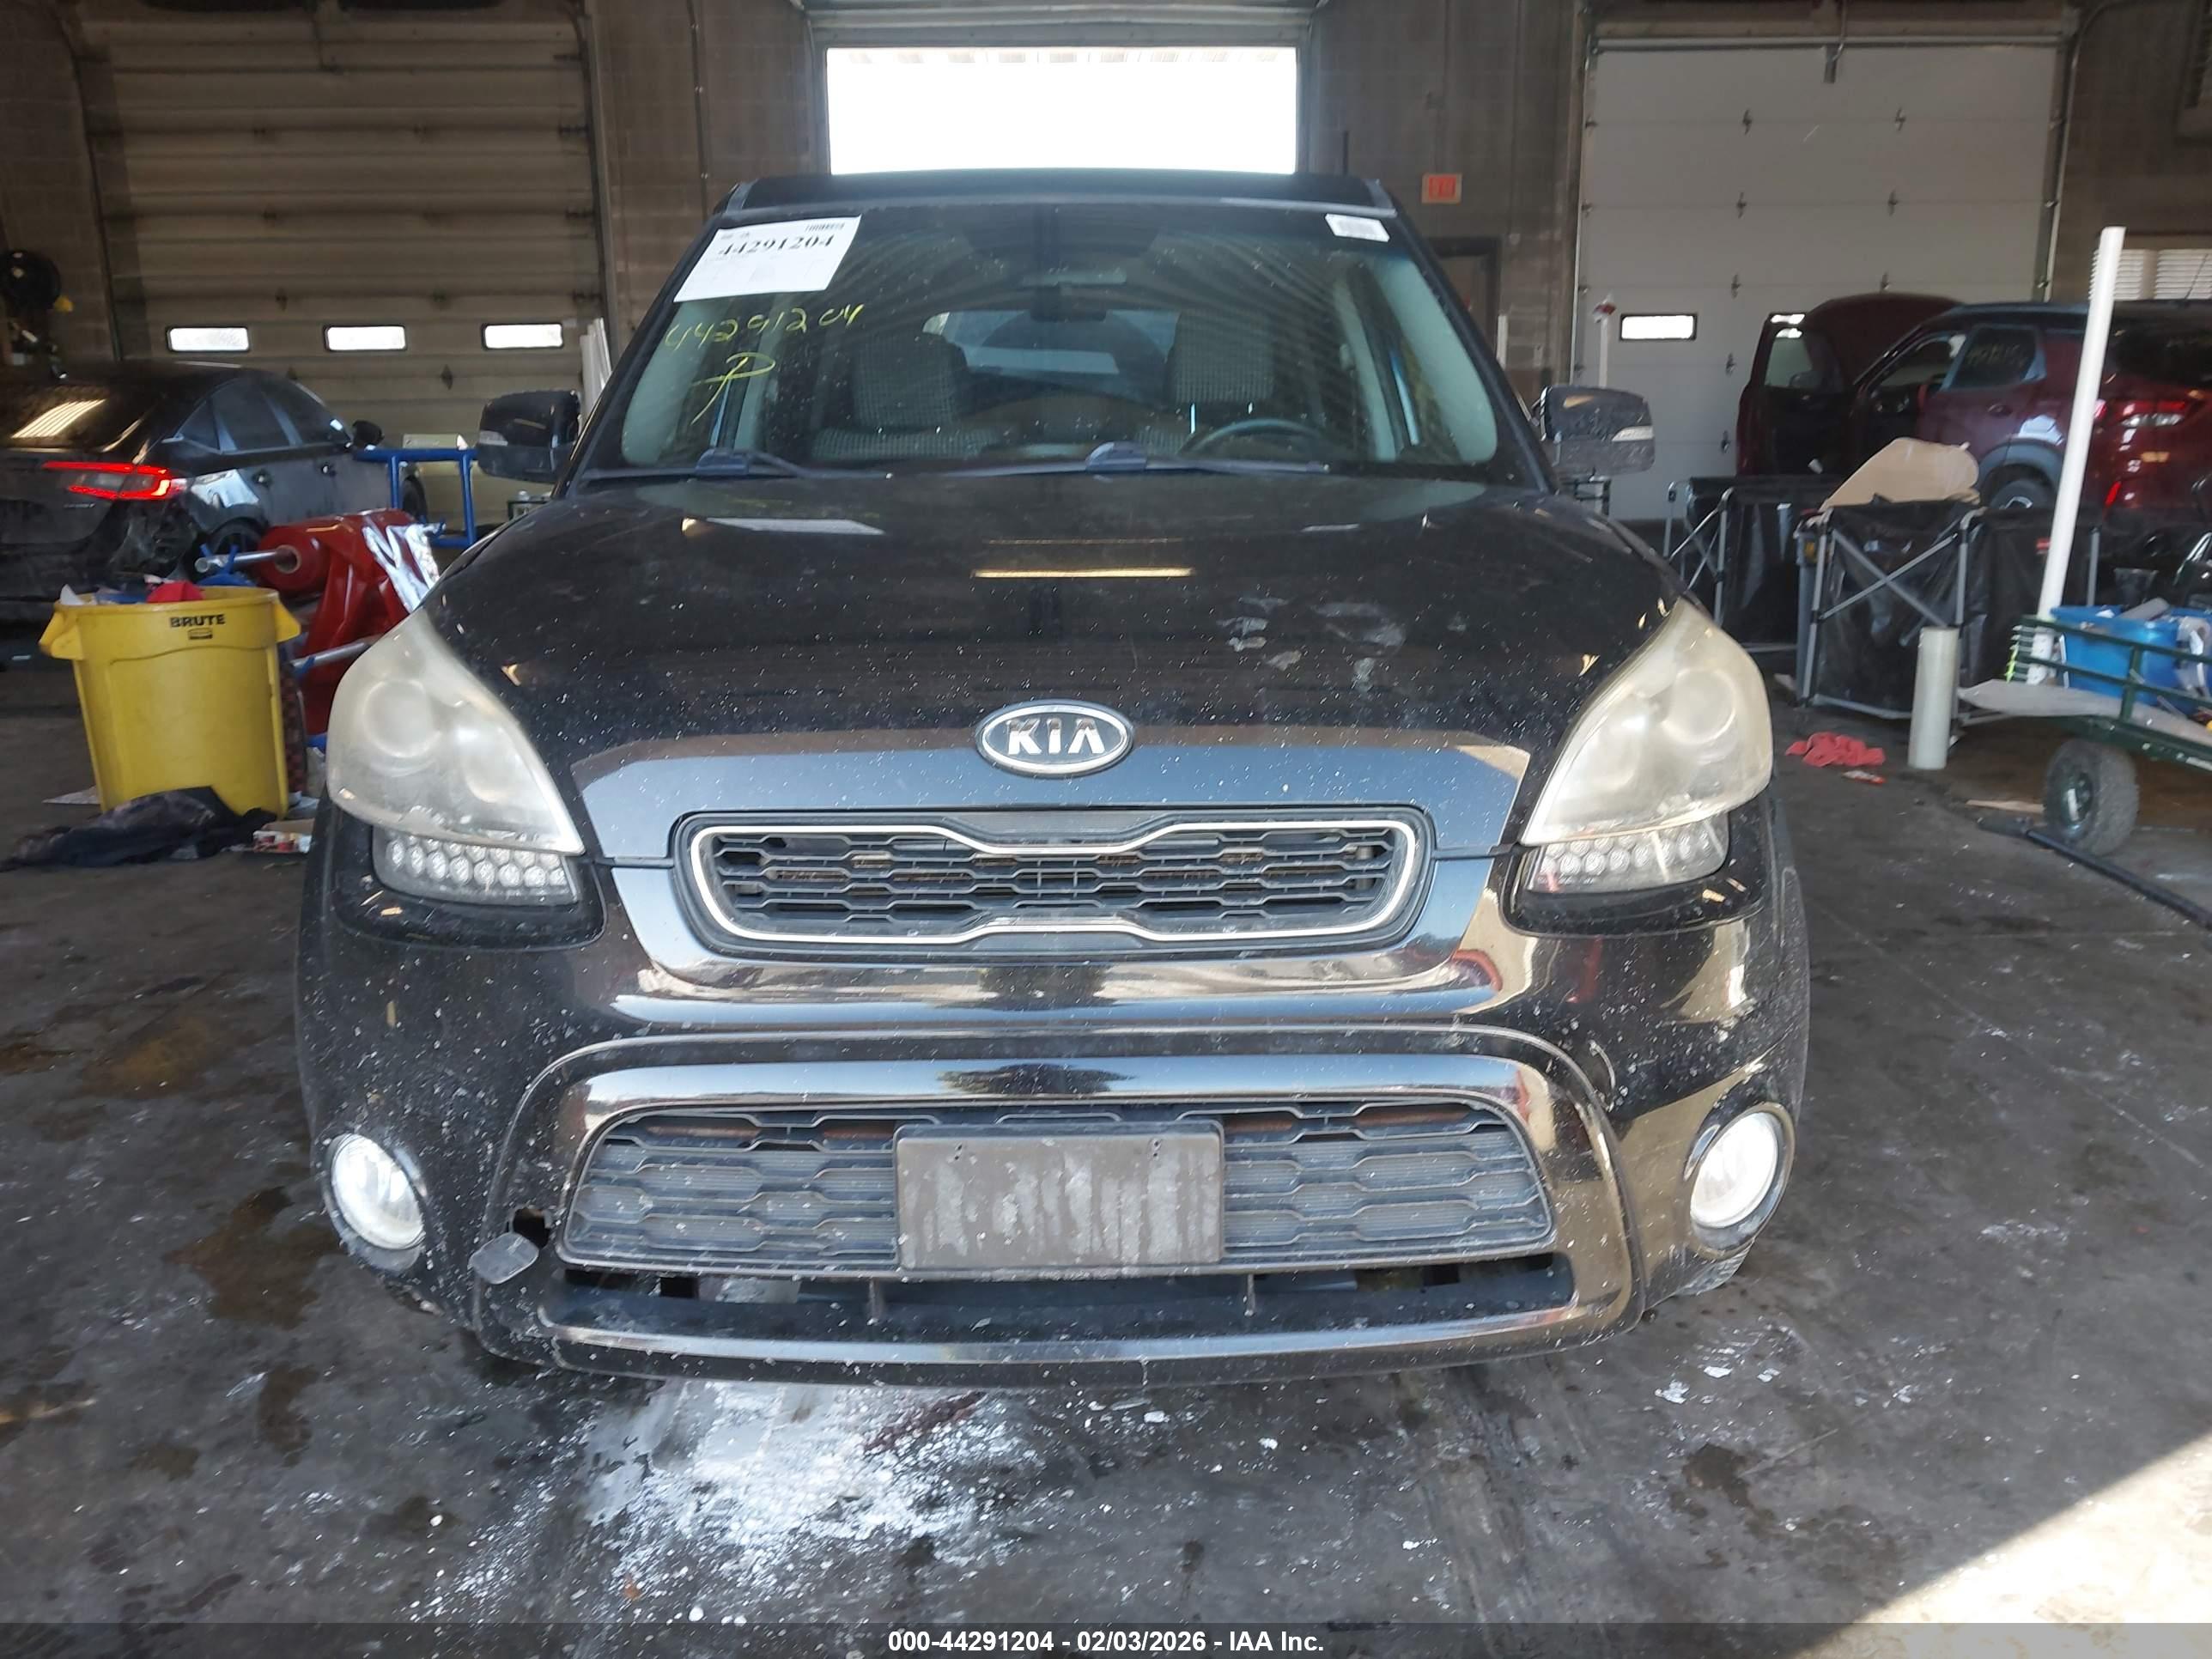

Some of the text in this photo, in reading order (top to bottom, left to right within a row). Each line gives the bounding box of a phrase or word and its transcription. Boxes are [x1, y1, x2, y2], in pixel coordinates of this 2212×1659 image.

[718, 234, 835, 256] 44291204
[170, 613, 225, 628] BRUTE
[1006, 718, 1106, 756] KIA
